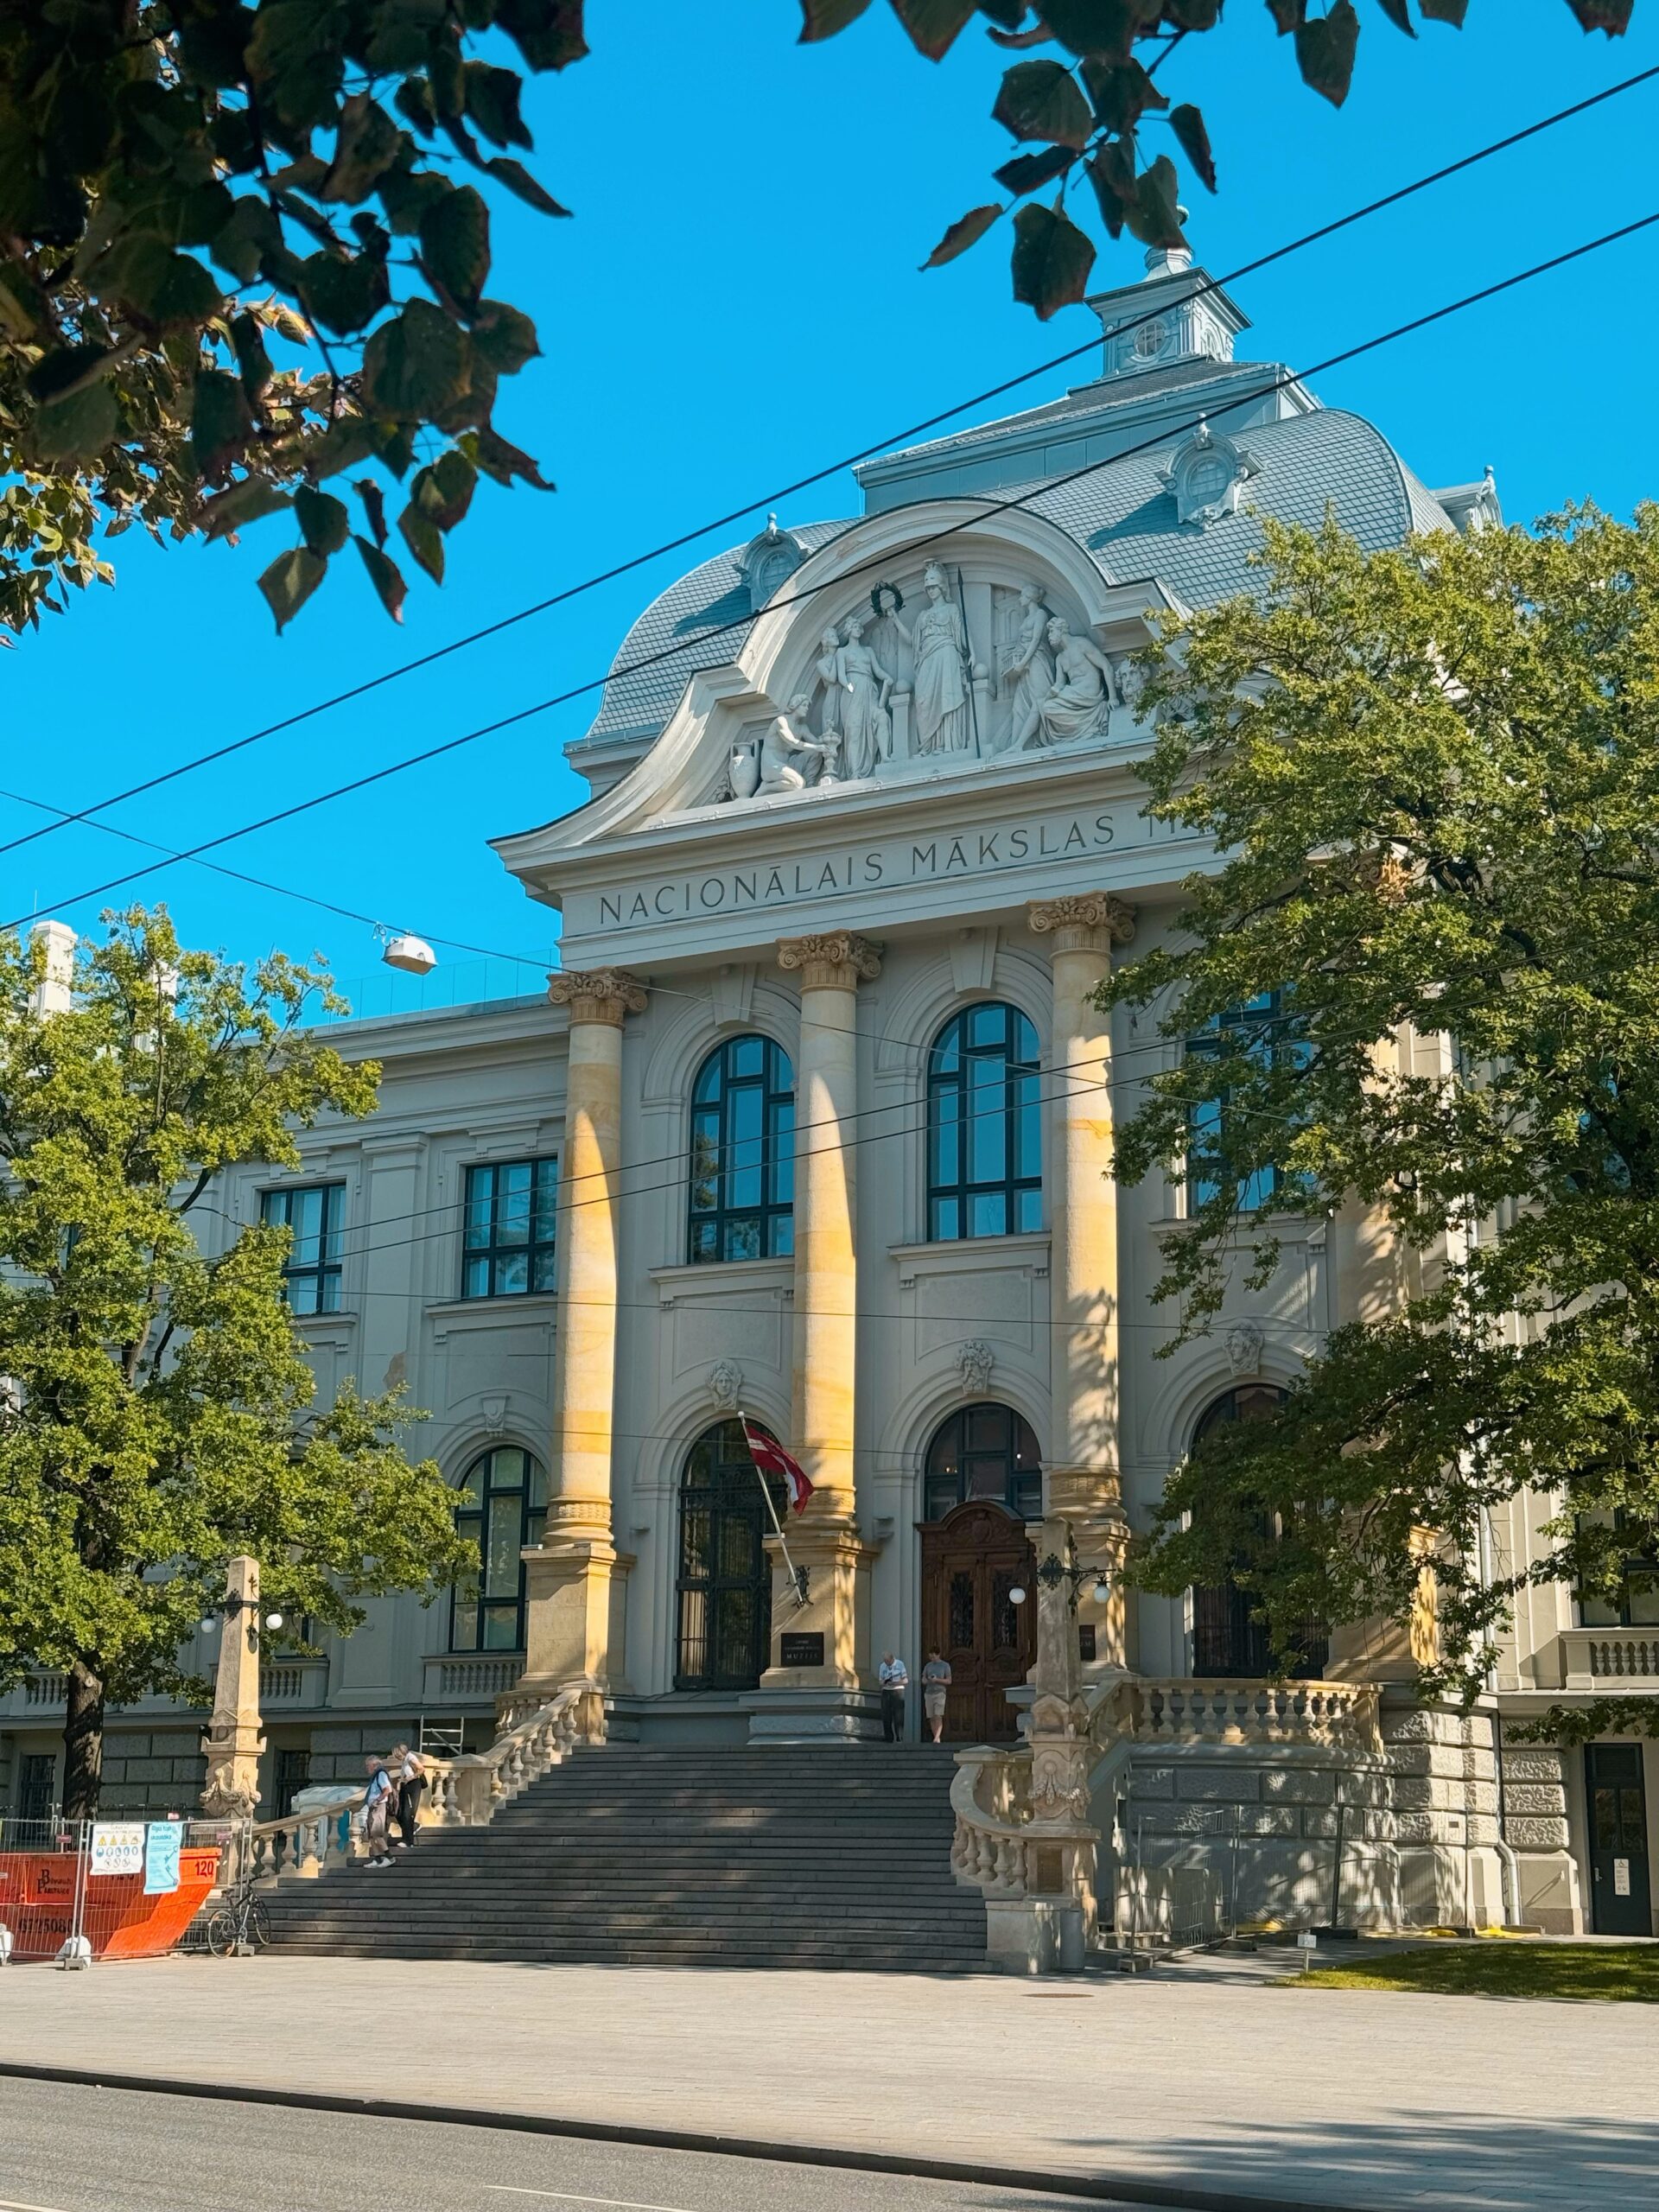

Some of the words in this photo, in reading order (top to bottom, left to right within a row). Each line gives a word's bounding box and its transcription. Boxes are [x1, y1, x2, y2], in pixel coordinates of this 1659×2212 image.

[599, 852, 884, 925] NACIONĀLAIS
[912, 815, 1115, 876] MĀKSLAS
[195, 1860, 214, 1877] 120
